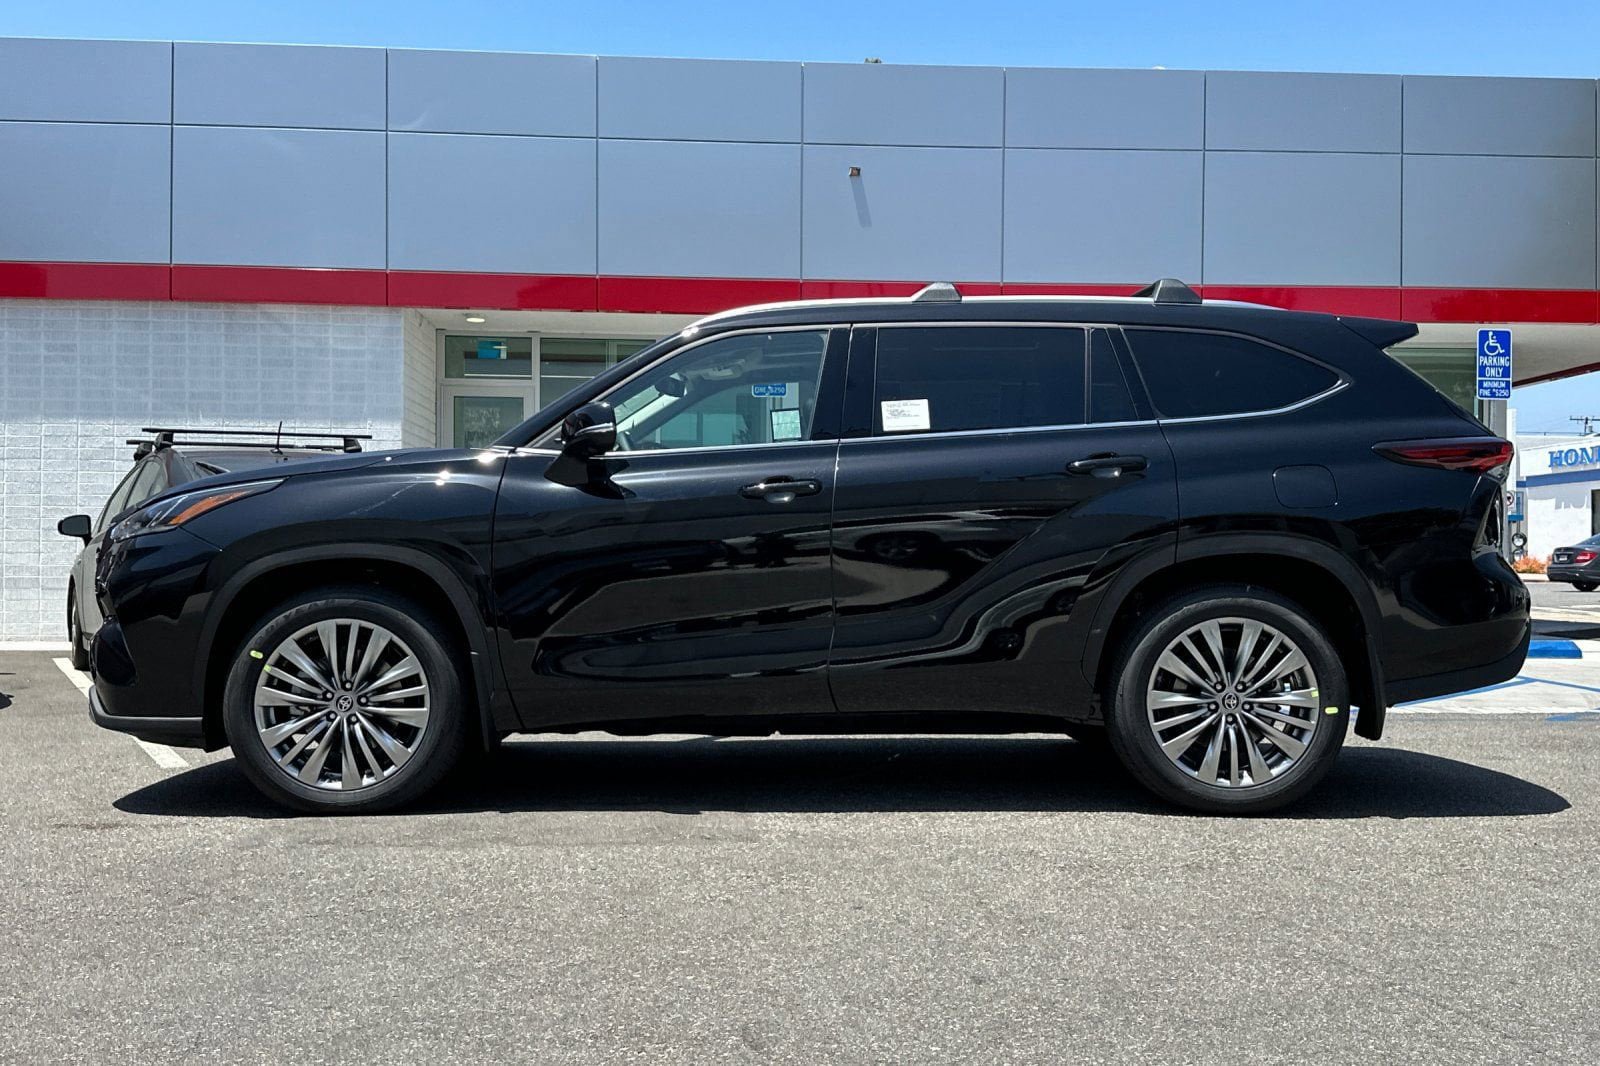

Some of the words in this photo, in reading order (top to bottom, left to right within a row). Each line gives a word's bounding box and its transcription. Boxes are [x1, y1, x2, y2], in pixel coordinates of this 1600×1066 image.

[1480, 356, 1510, 367] PARKING
[1485, 367, 1504, 377] ONLY
[1480, 389, 1491, 397] FINE
[1495, 389, 1509, 397] $250
[1548, 445, 1600, 468] HON
